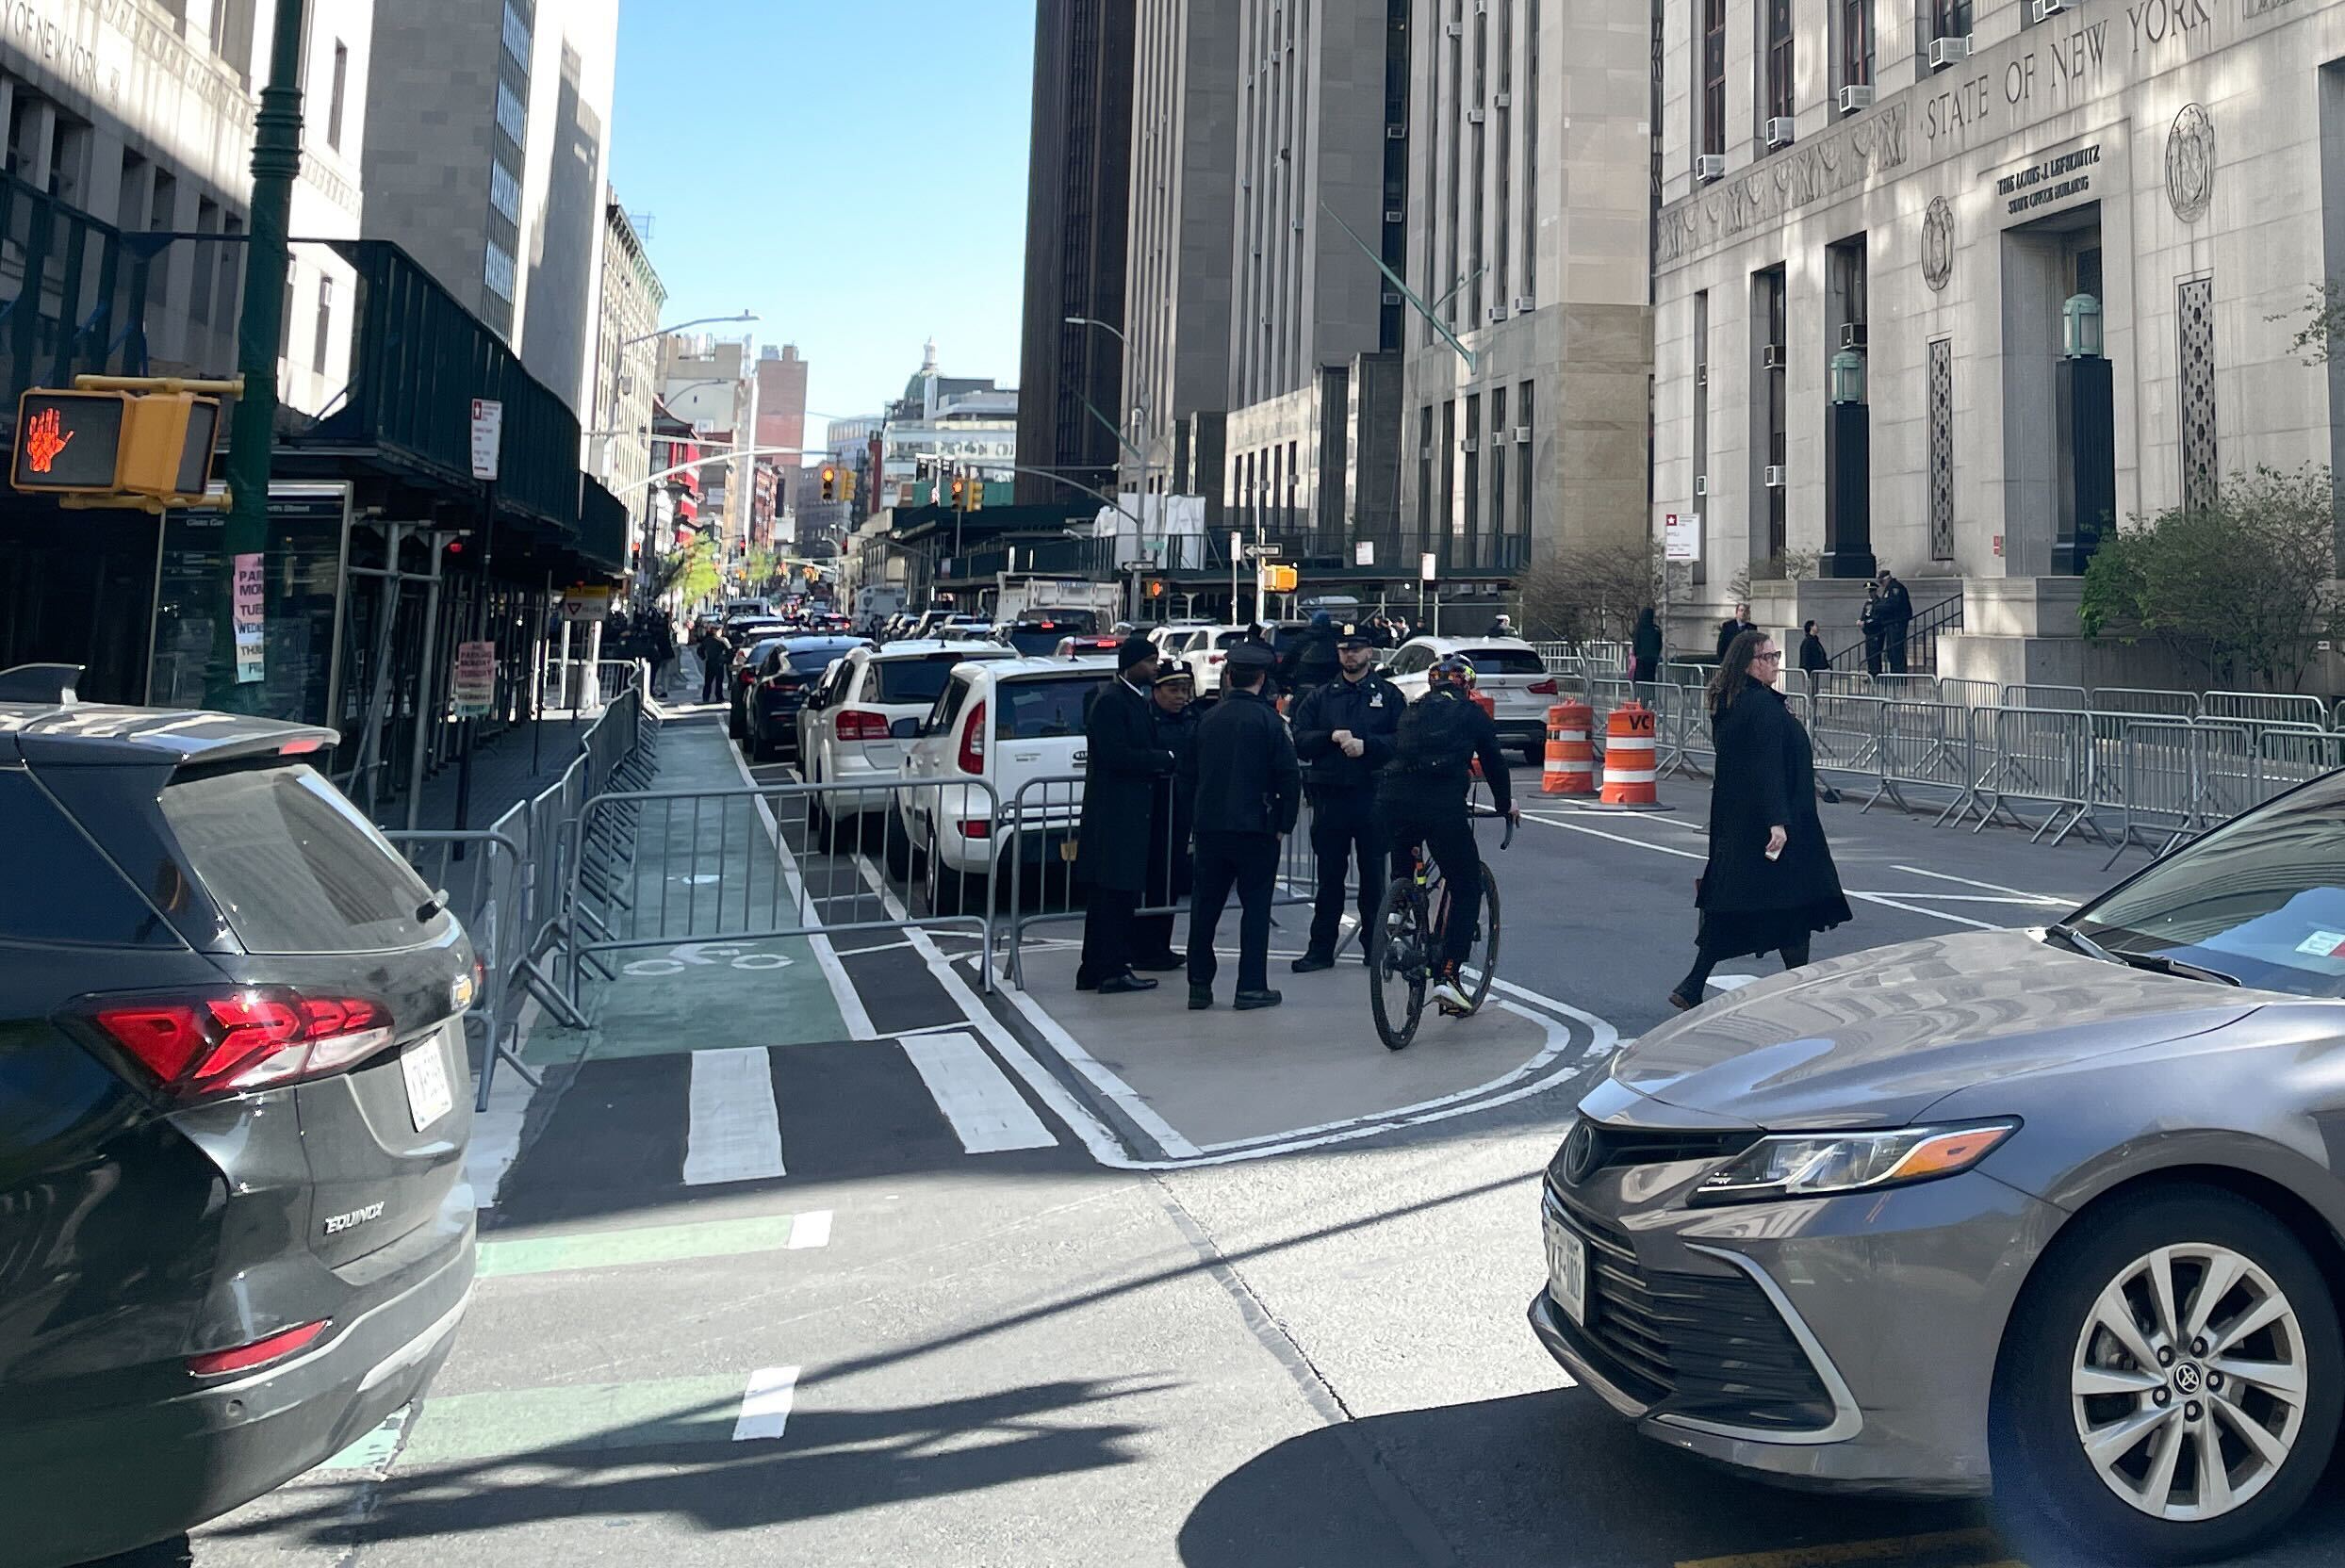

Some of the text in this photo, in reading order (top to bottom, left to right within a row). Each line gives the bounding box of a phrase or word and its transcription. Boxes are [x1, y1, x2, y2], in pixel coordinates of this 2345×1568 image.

[14, 2, 35, 53] OF
[35, 15, 67, 79] NEW
[68, 38, 99, 94] YORK
[1927, 0, 2211, 139] STATE OF NEW YORK
[1997, 174, 2015, 196] THE
[2016, 166, 2041, 190] LOUIS
[2050, 144, 2101, 178] LEFKOWITZ
[2008, 175, 2090, 215] STATE OFFICE BUILDING
[238, 570, 264, 582] PAR
[239, 584, 264, 596] MON
[239, 605, 264, 616] TUE
[325, 1201, 385, 1234] EQUINOX
